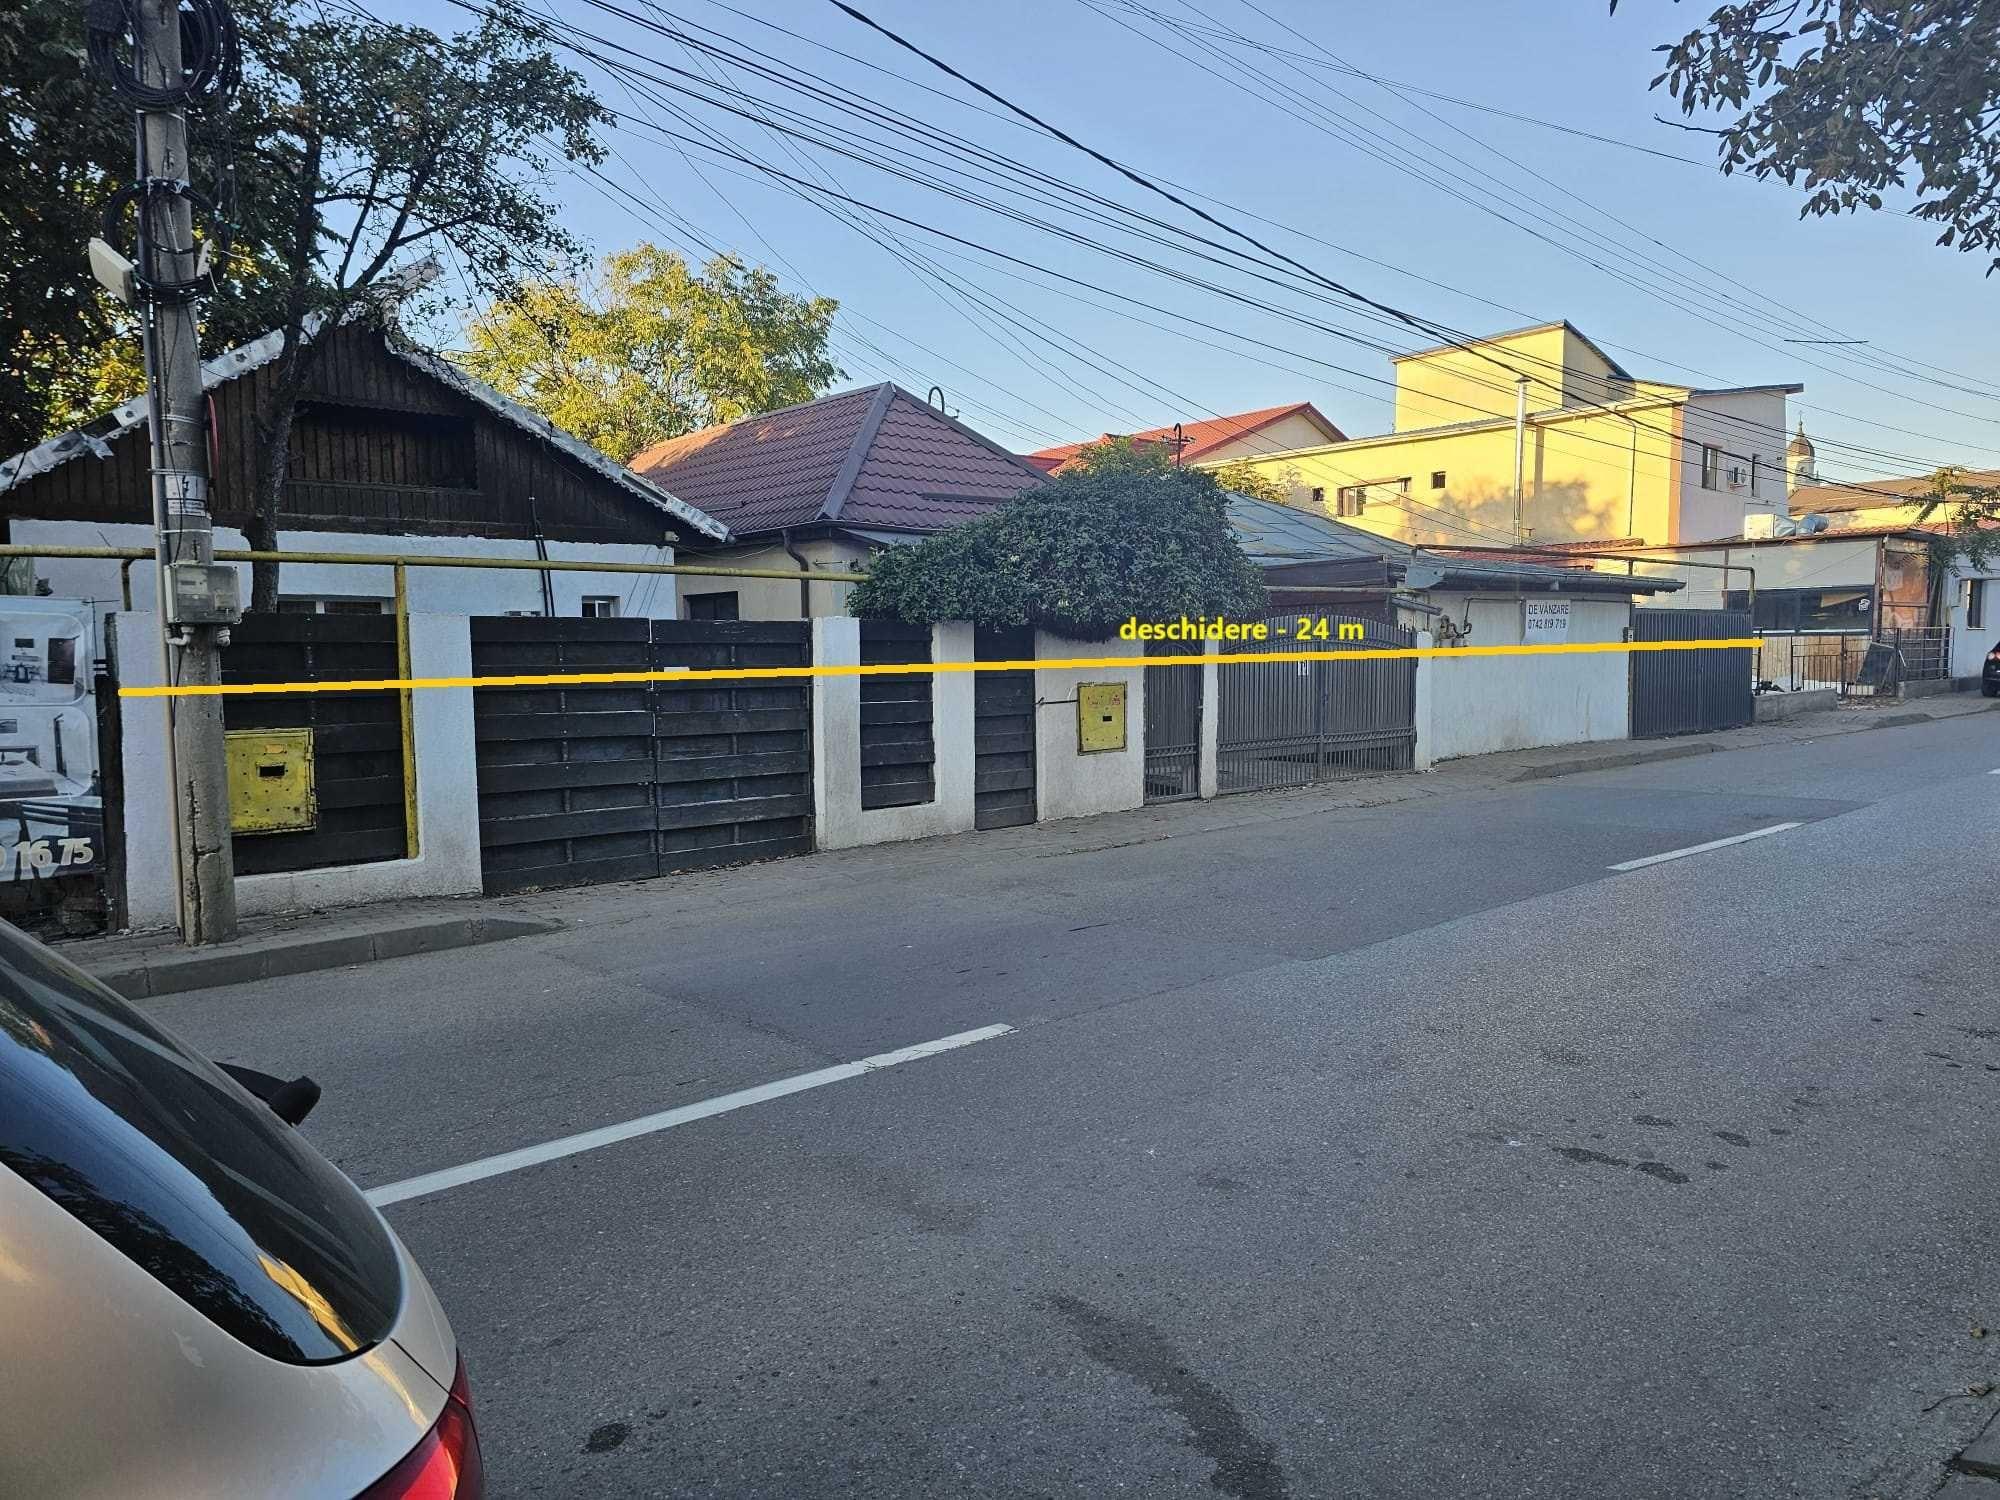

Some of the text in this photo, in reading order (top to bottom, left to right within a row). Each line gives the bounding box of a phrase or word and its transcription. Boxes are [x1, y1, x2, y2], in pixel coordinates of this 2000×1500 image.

[1528, 604, 1538, 615] DE
[1528, 618, 1543, 629] 0742
[15, 840, 53, 869] 16
[57, 837, 94, 866] 75
